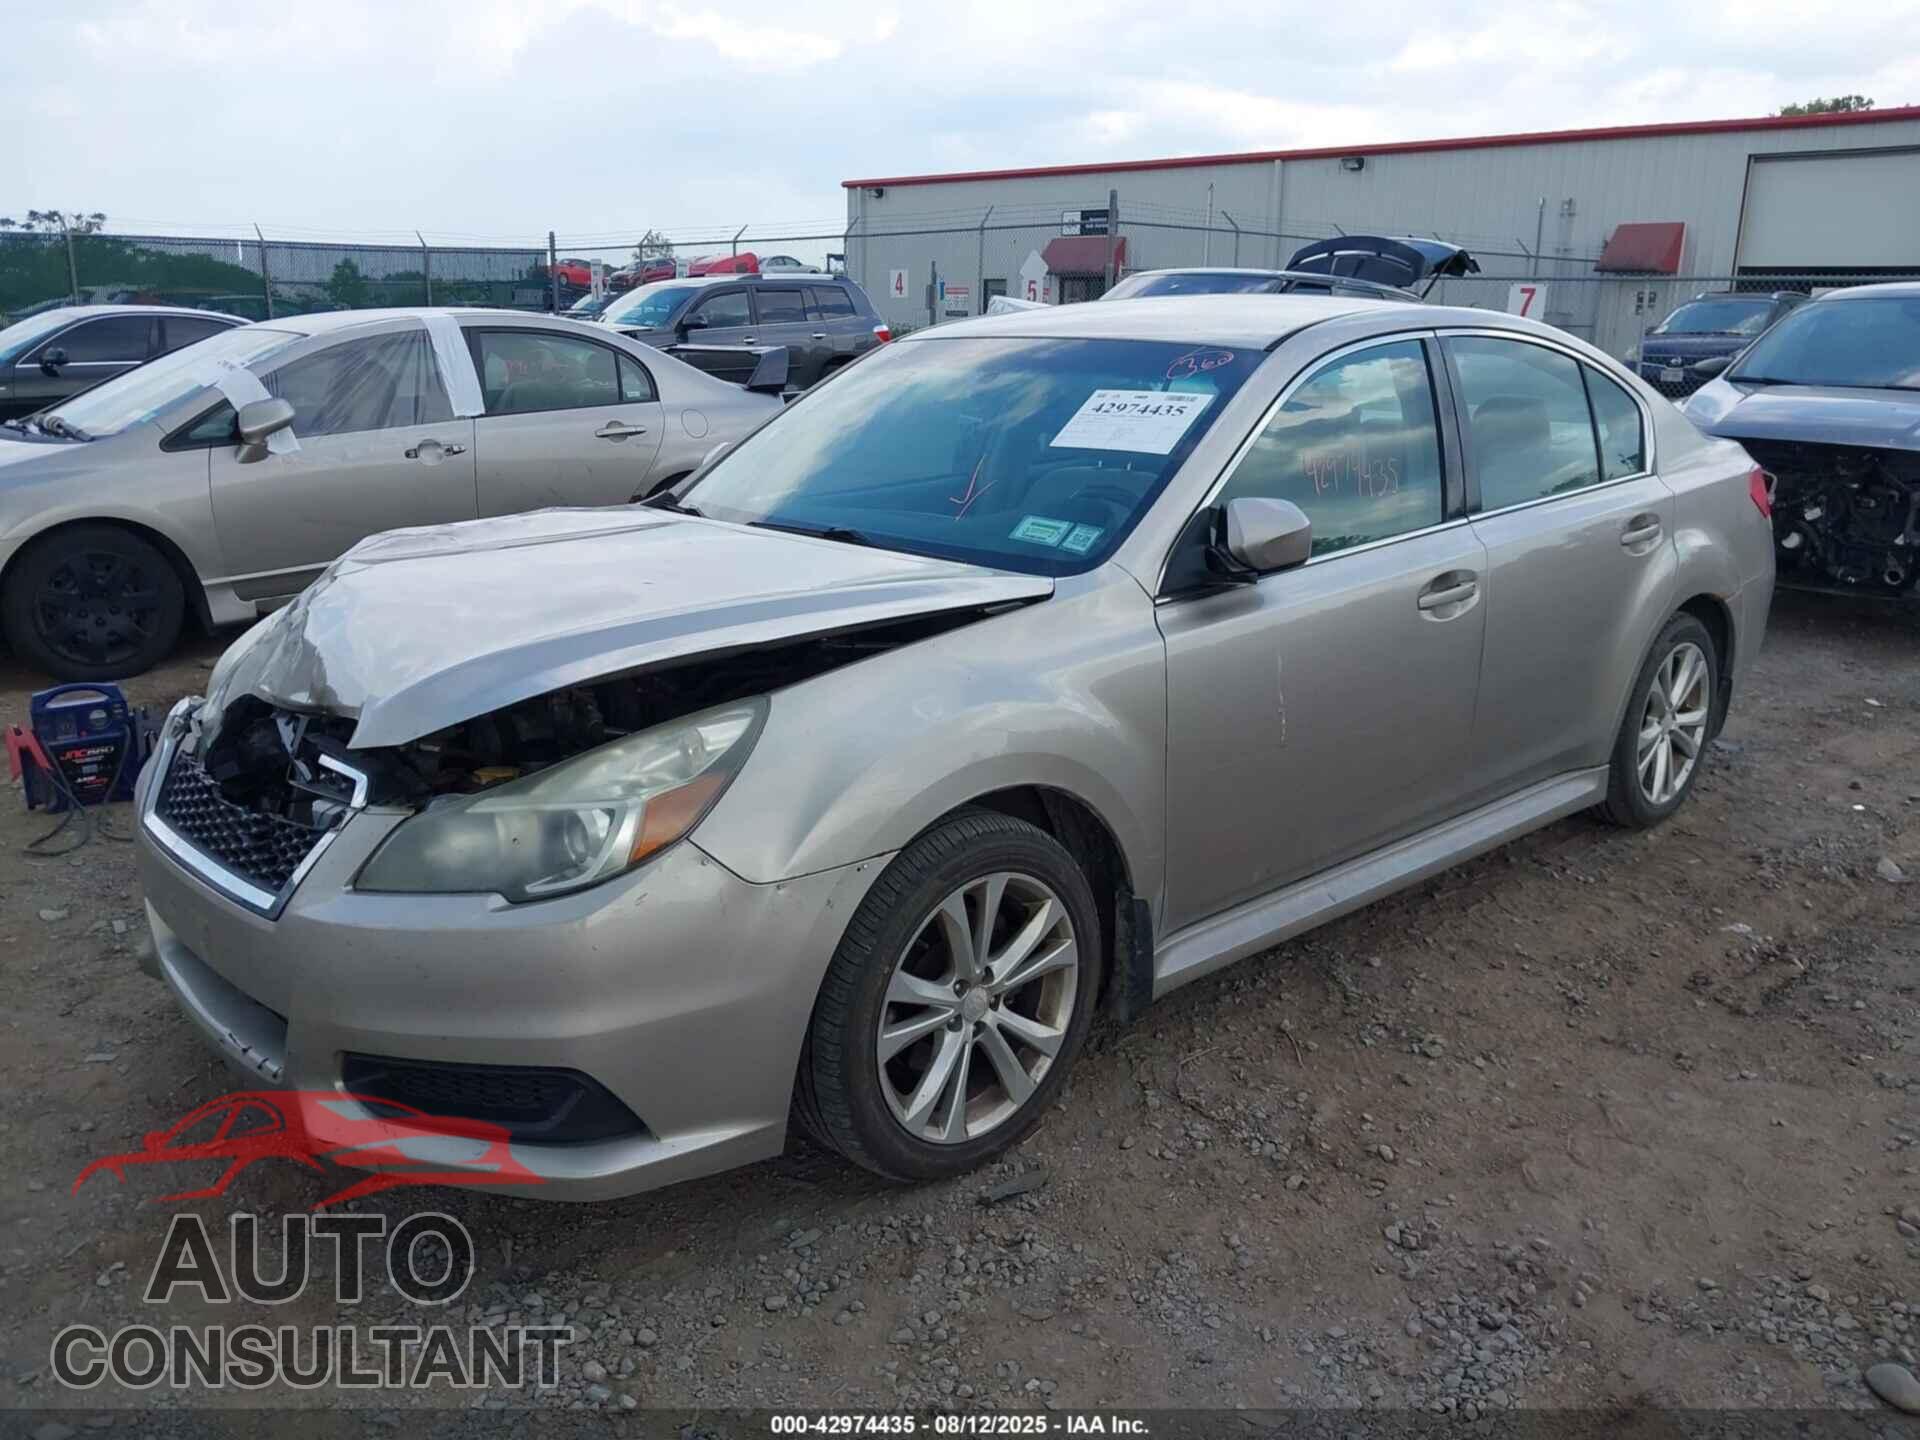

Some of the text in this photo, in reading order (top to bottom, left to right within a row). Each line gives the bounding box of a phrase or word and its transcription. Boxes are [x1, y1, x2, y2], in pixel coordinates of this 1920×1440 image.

[896, 271, 904, 296] 4
[1027, 279, 1037, 302] 5
[1519, 287, 1537, 317] 7
[1091, 401, 1188, 417] 42974435
